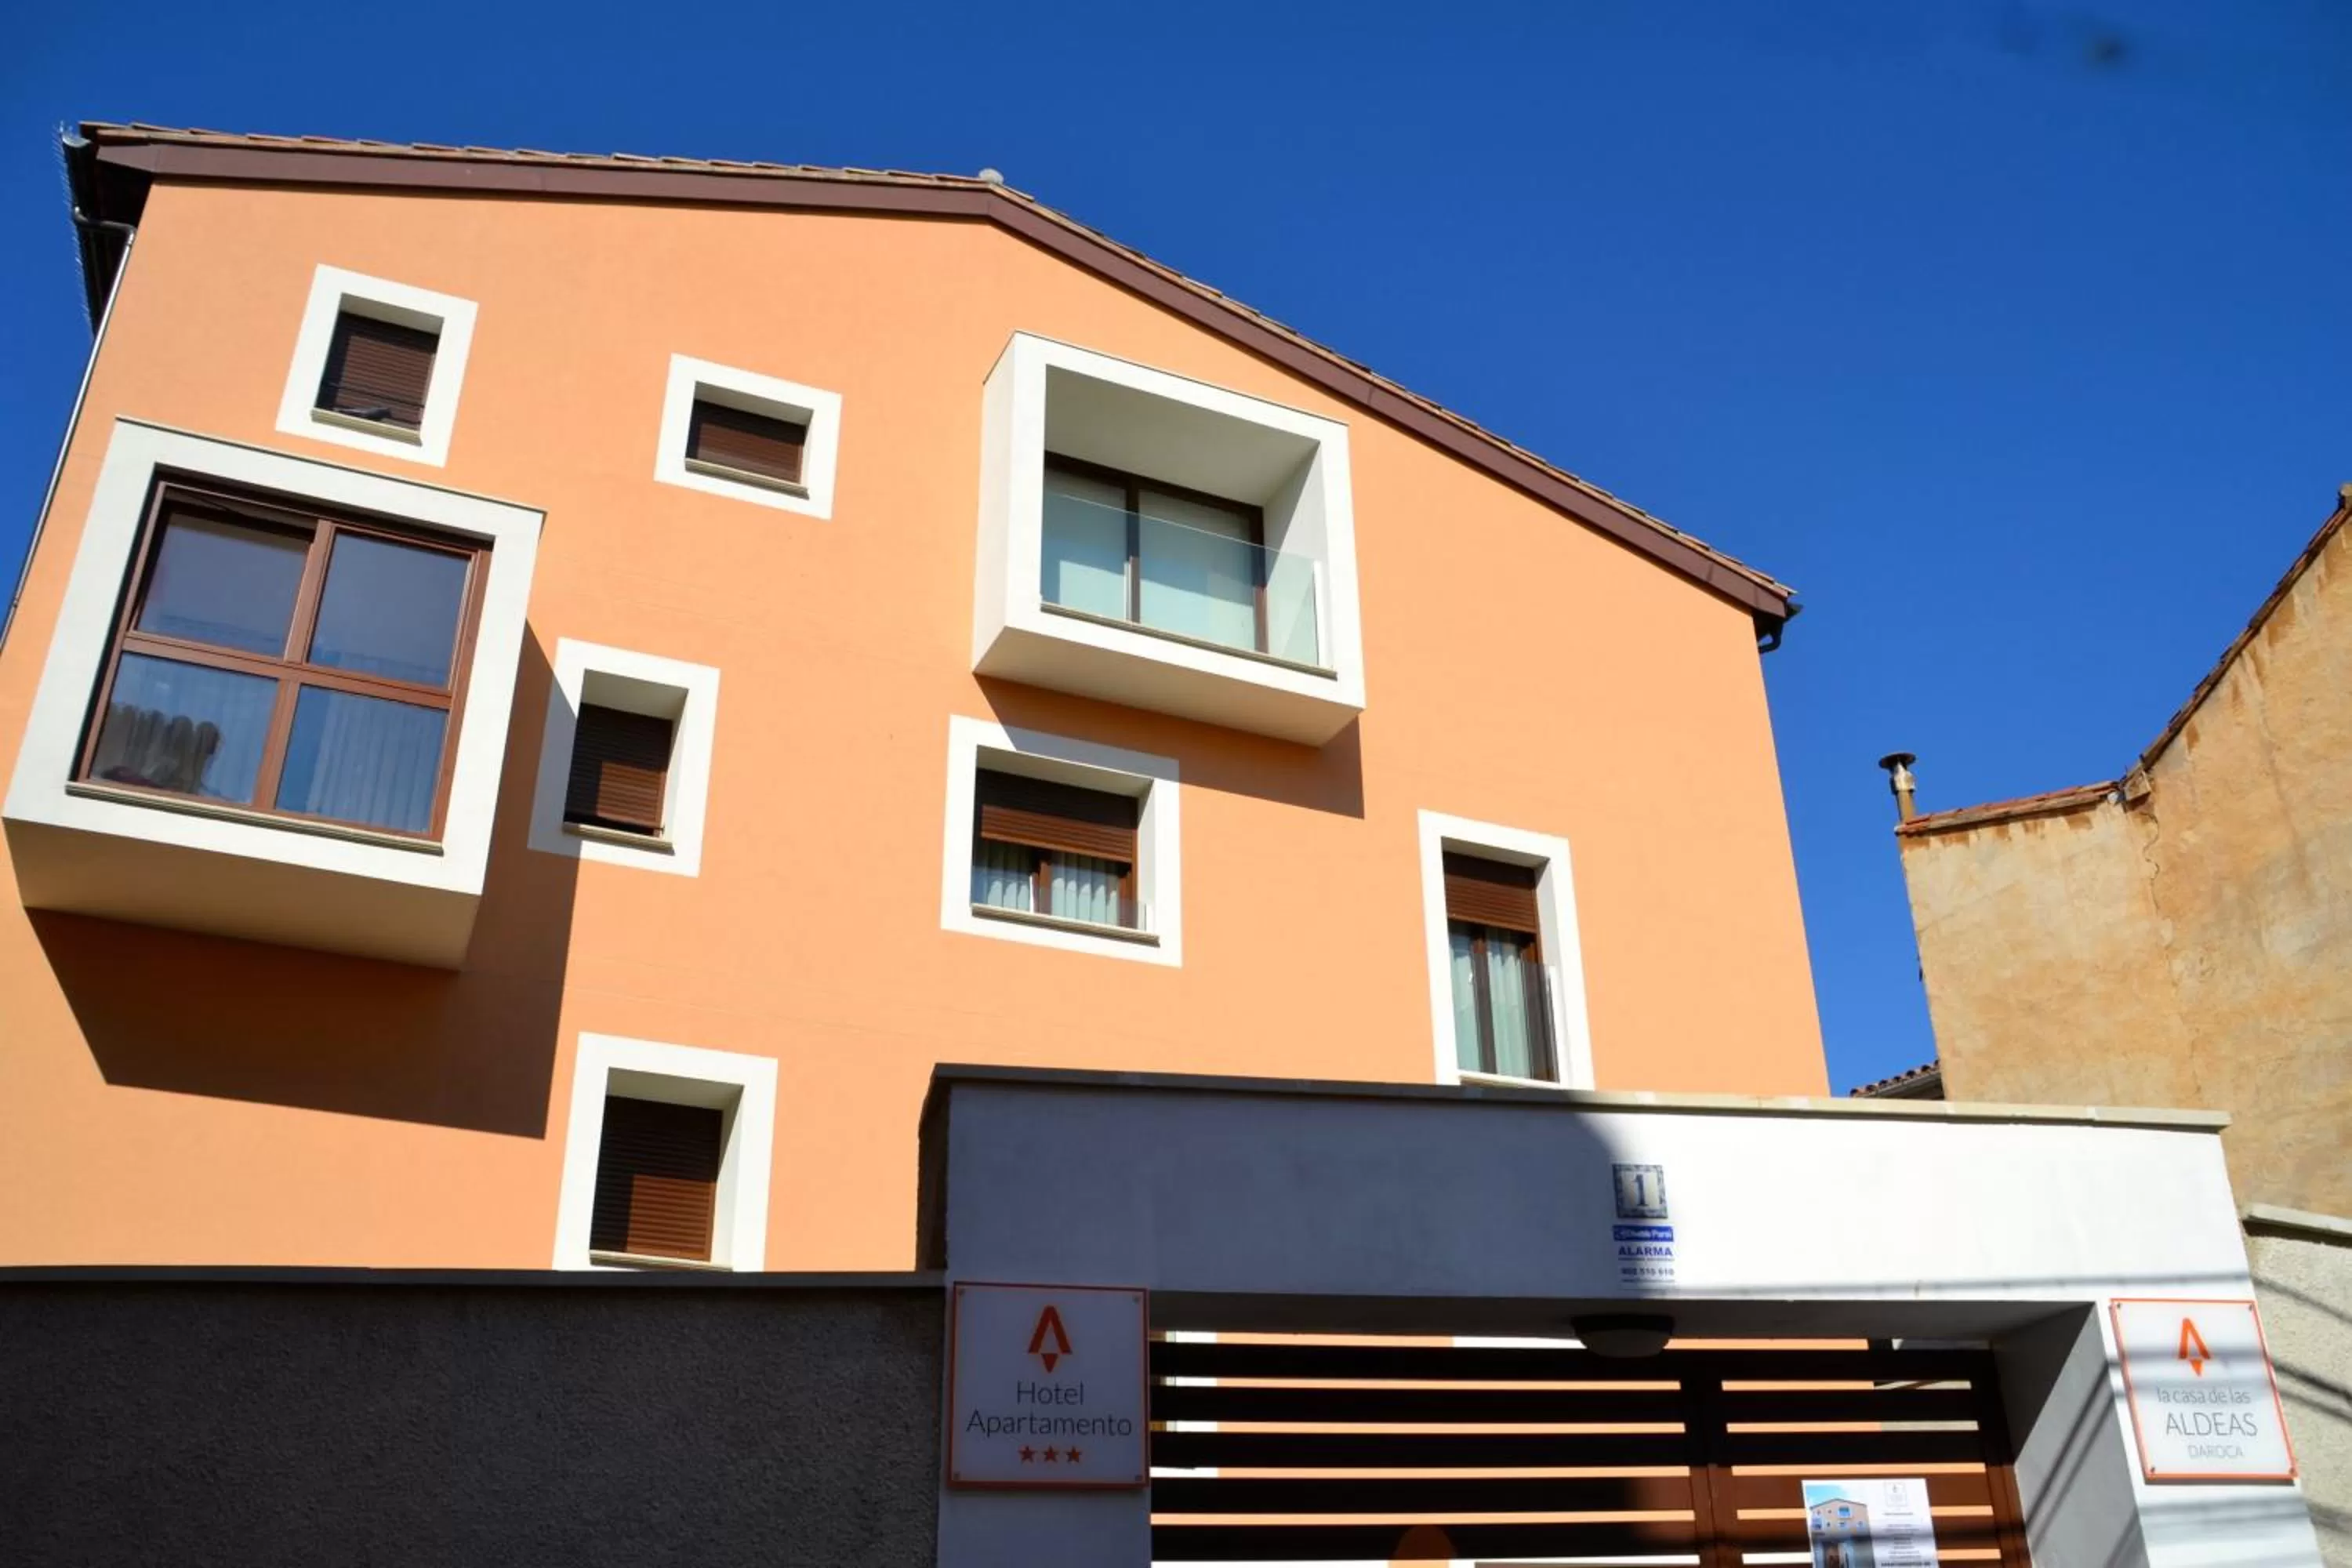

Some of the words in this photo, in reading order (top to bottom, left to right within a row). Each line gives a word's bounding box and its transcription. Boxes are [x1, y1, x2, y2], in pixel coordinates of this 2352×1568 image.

[1632, 1174, 1649, 1207] 1
[1618, 1246, 1673, 1256] ALARMA
[1017, 1381, 1084, 1405] Hotel
[2157, 1387, 2170, 1403] la
[2172, 1390, 2206, 1403] casa
[2207, 1386, 2227, 1403] de
[2229, 1388, 2252, 1403] las
[966, 1409, 1132, 1437] Apartamento
[2166, 1412, 2258, 1436] ALDEAS
[2187, 1445, 2244, 1459] DAROCA
